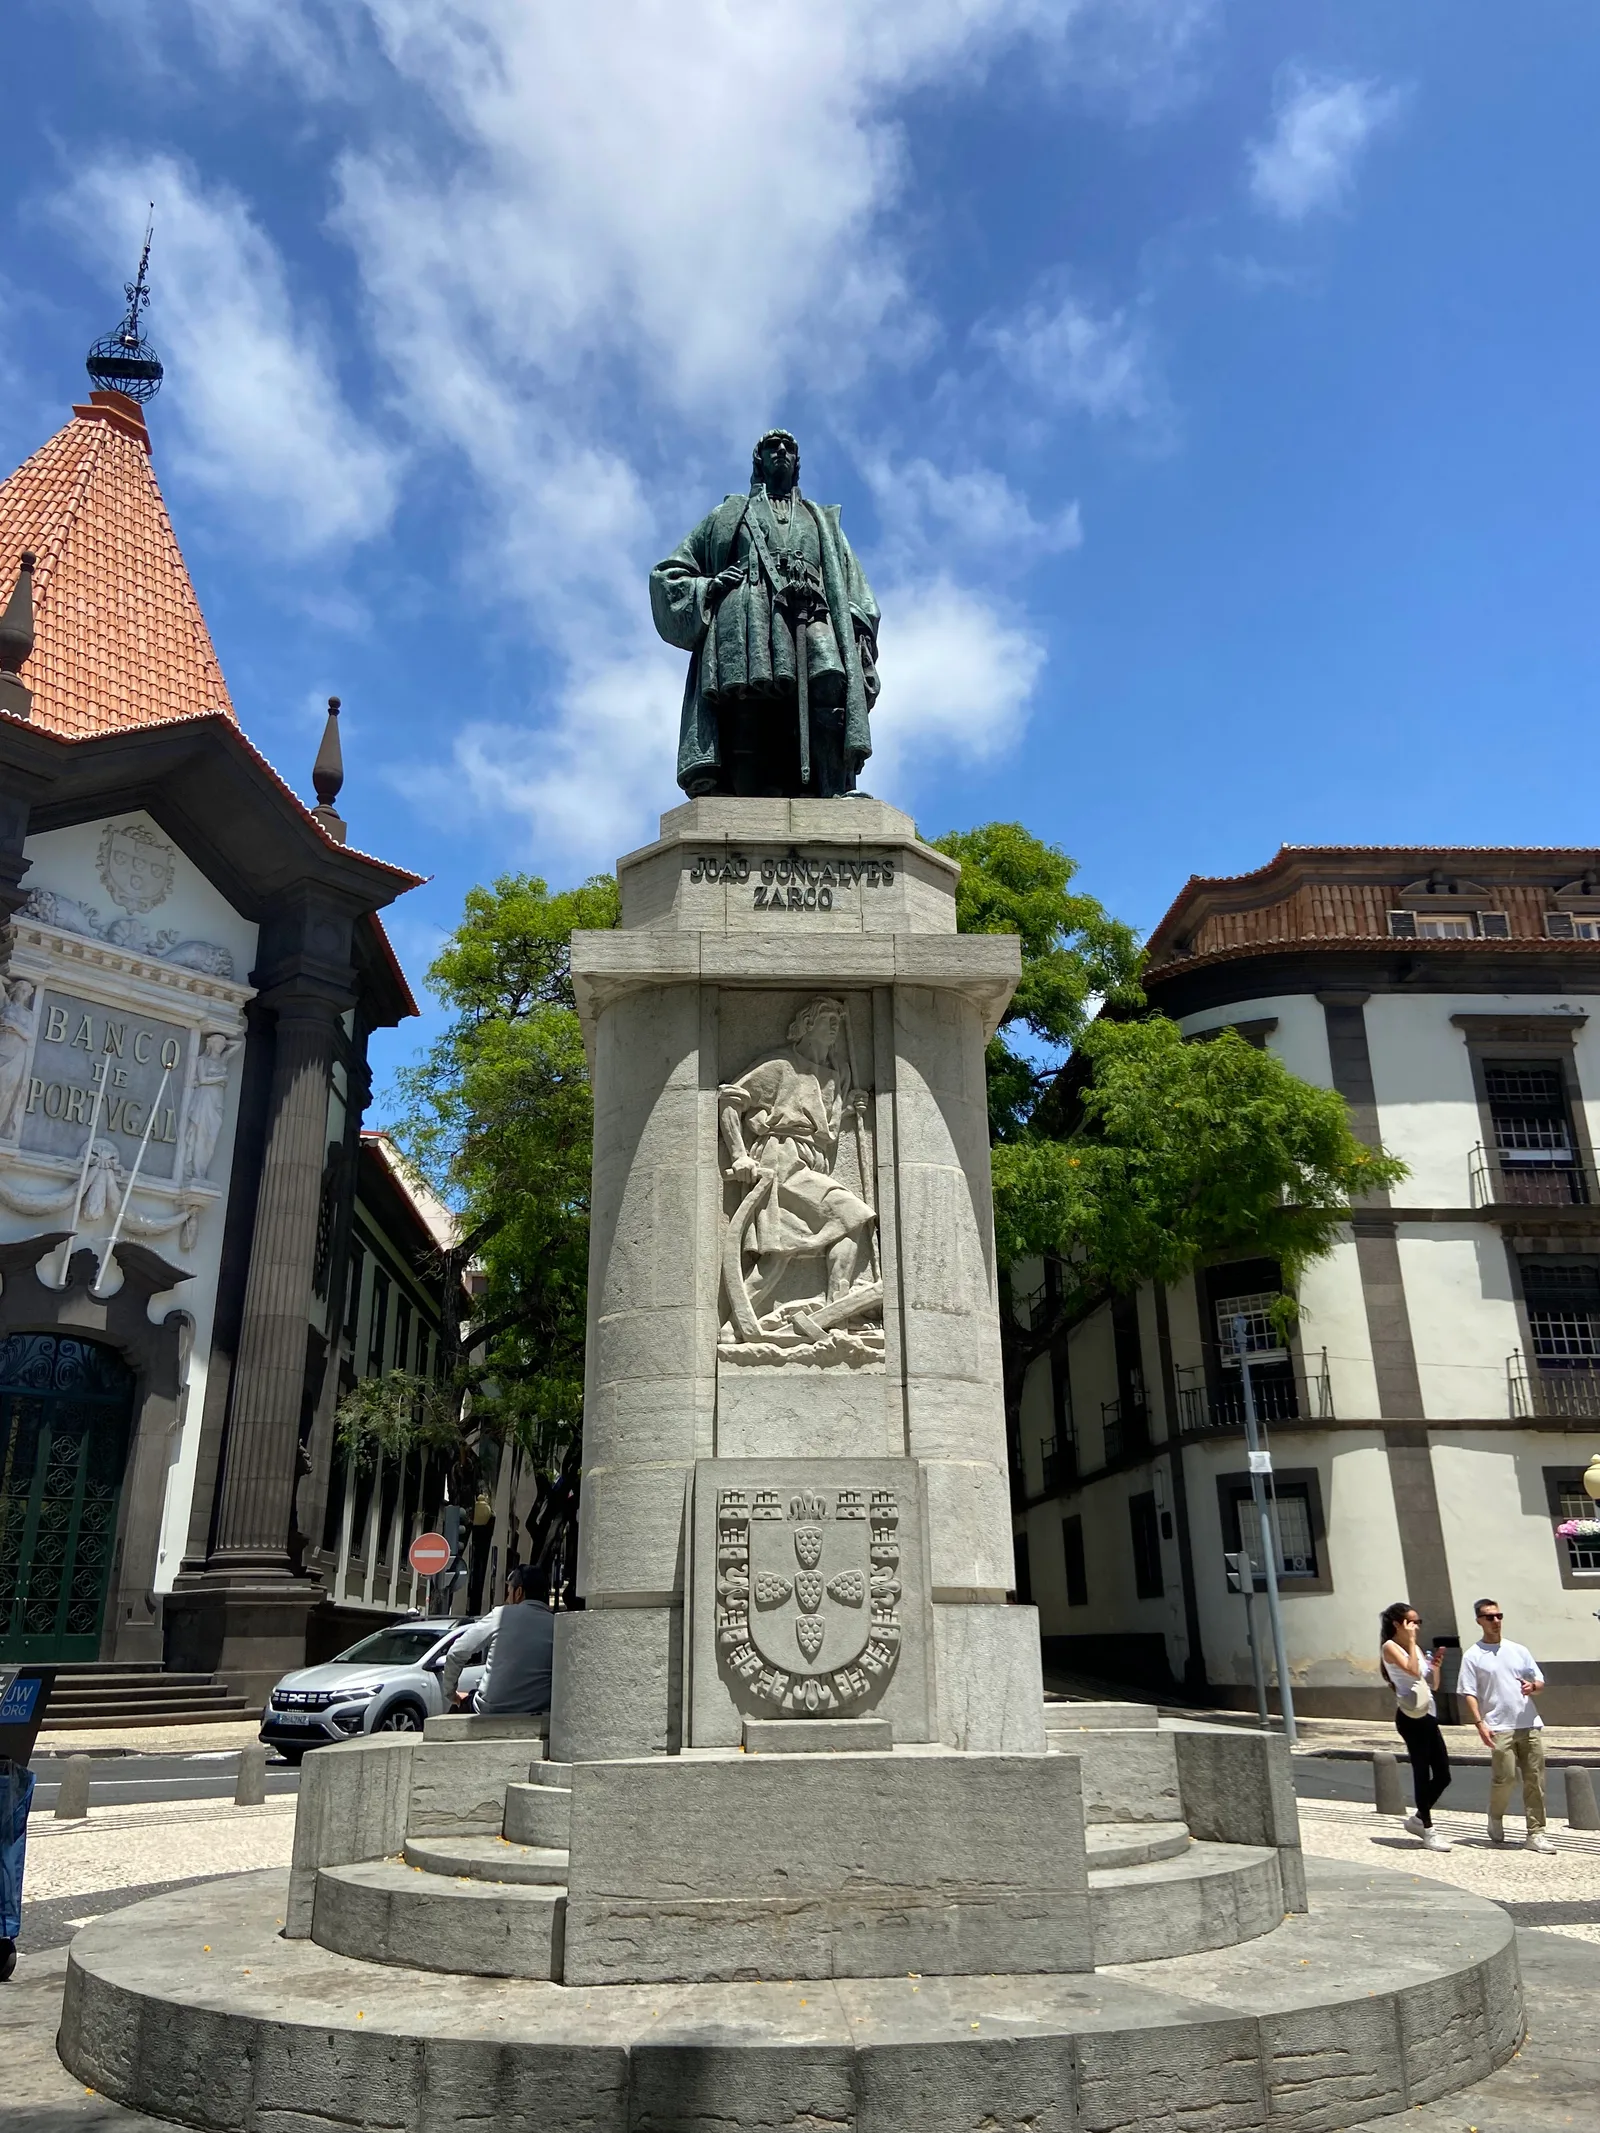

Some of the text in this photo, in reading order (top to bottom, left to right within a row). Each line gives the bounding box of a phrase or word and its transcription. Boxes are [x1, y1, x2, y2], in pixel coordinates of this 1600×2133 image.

[760, 860, 895, 885] GONÇALVES
[754, 886, 833, 908] ZARCO
[44, 1006, 180, 1070] BANCO
[92, 1063, 128, 1088] DE
[5, 1686, 33, 1702] JW
